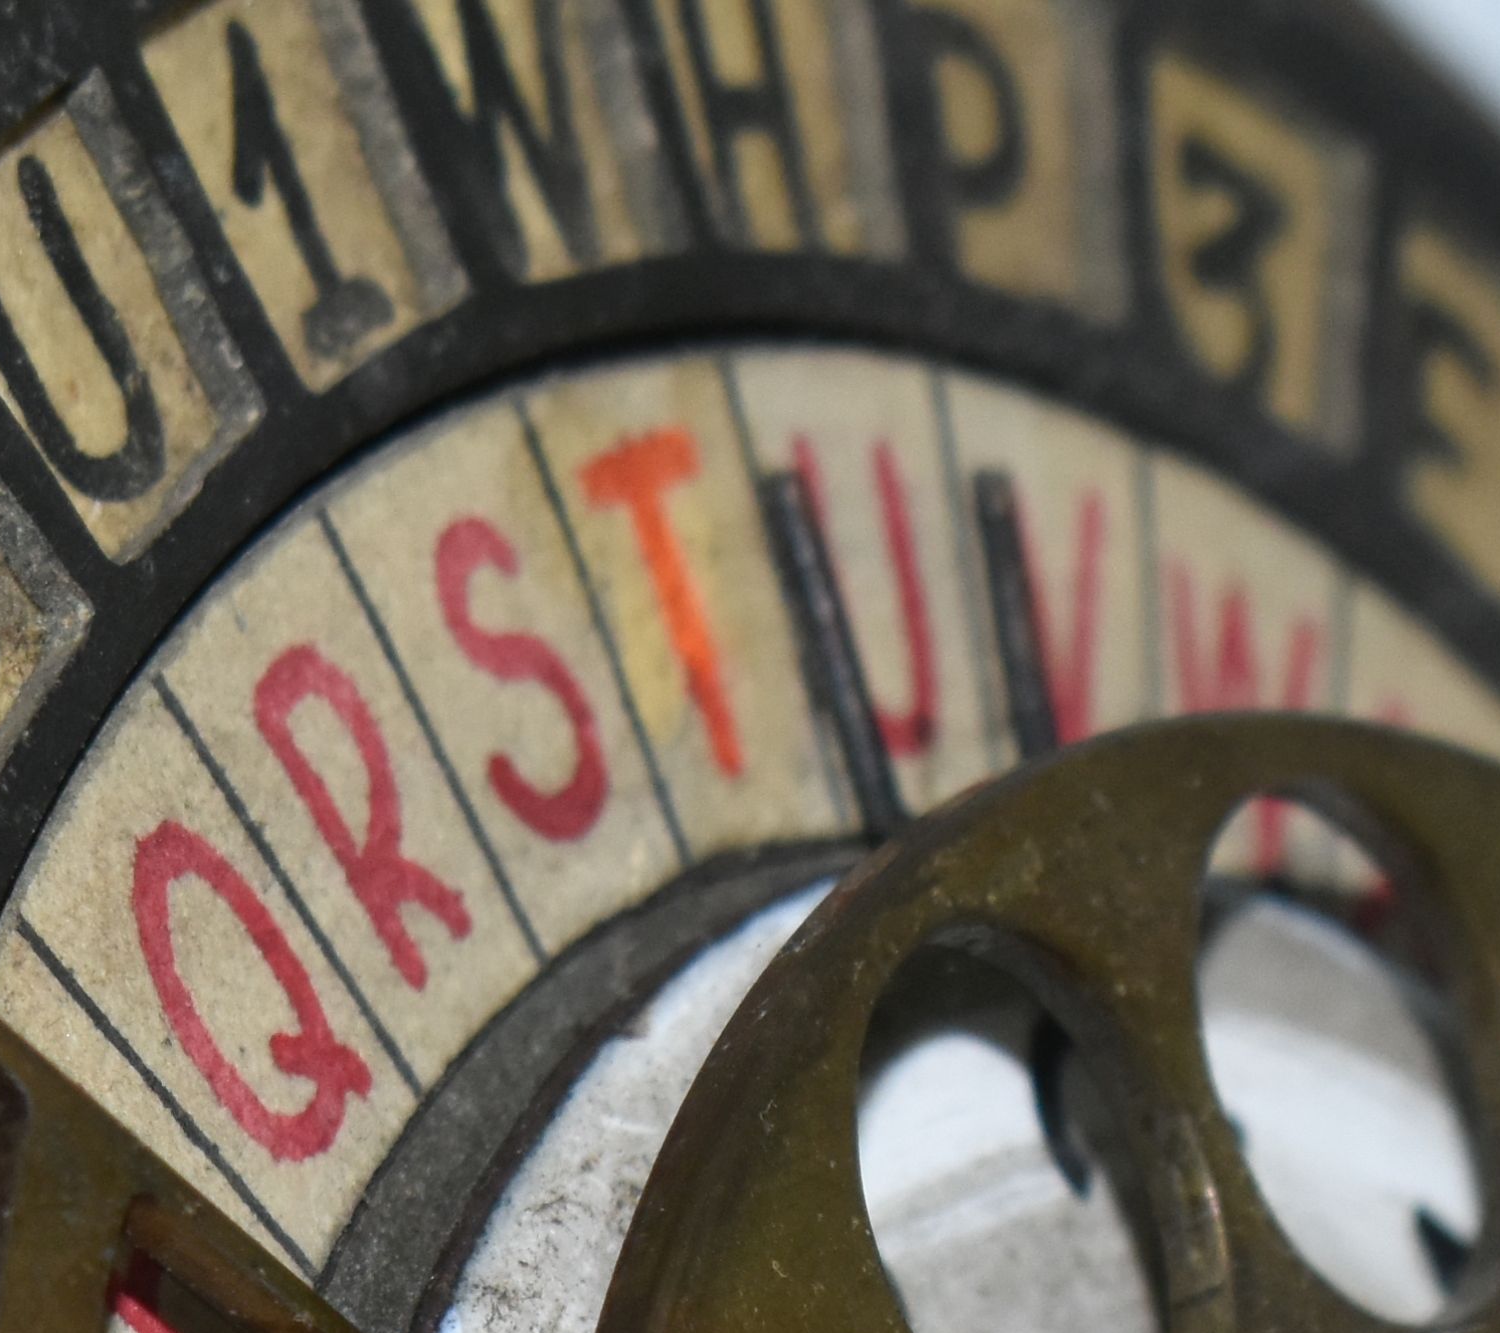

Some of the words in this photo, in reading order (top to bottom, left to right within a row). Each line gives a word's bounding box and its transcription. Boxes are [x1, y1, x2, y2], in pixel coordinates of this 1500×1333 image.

[223, 20, 396, 358] 1
[672, 0, 815, 256] H
[875, 5, 1028, 295] P
[131, 820, 373, 1163] Q
[252, 643, 472, 990] R
[433, 515, 610, 843] S
[574, 423, 746, 780] T
[782, 430, 939, 760] U
